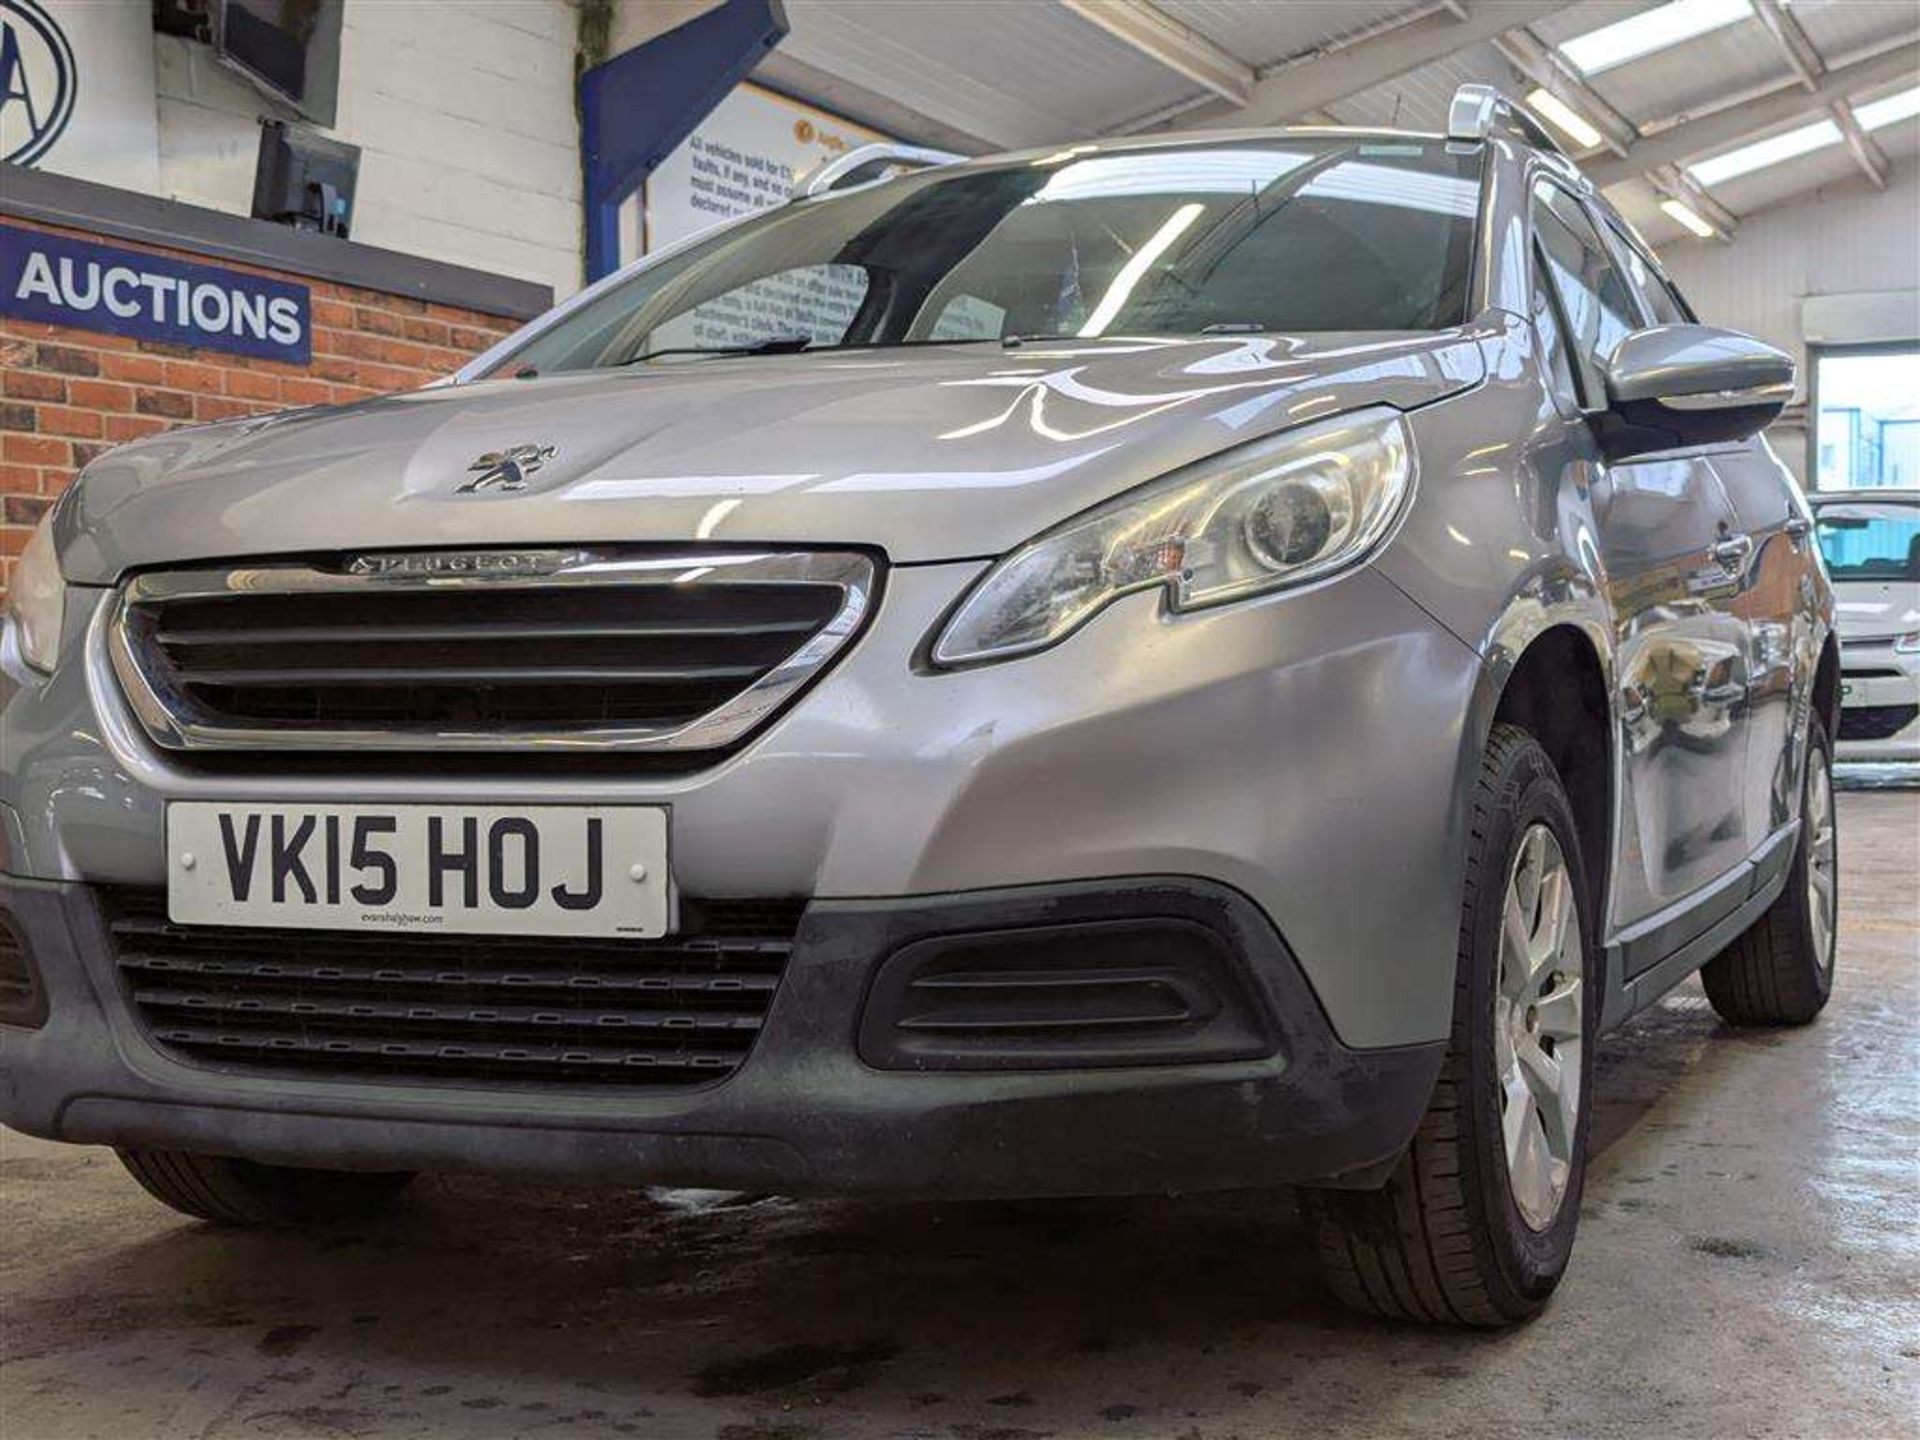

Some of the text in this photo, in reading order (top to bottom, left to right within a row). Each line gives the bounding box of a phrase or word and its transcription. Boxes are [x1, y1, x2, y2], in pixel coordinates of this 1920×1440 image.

[705, 141, 742, 164] vehicles
[745, 155, 763, 171] sold
[15, 252, 301, 344] AUCTIONS
[379, 556, 541, 572] PEUGEOT
[218, 814, 602, 911] VK15 HOJ
